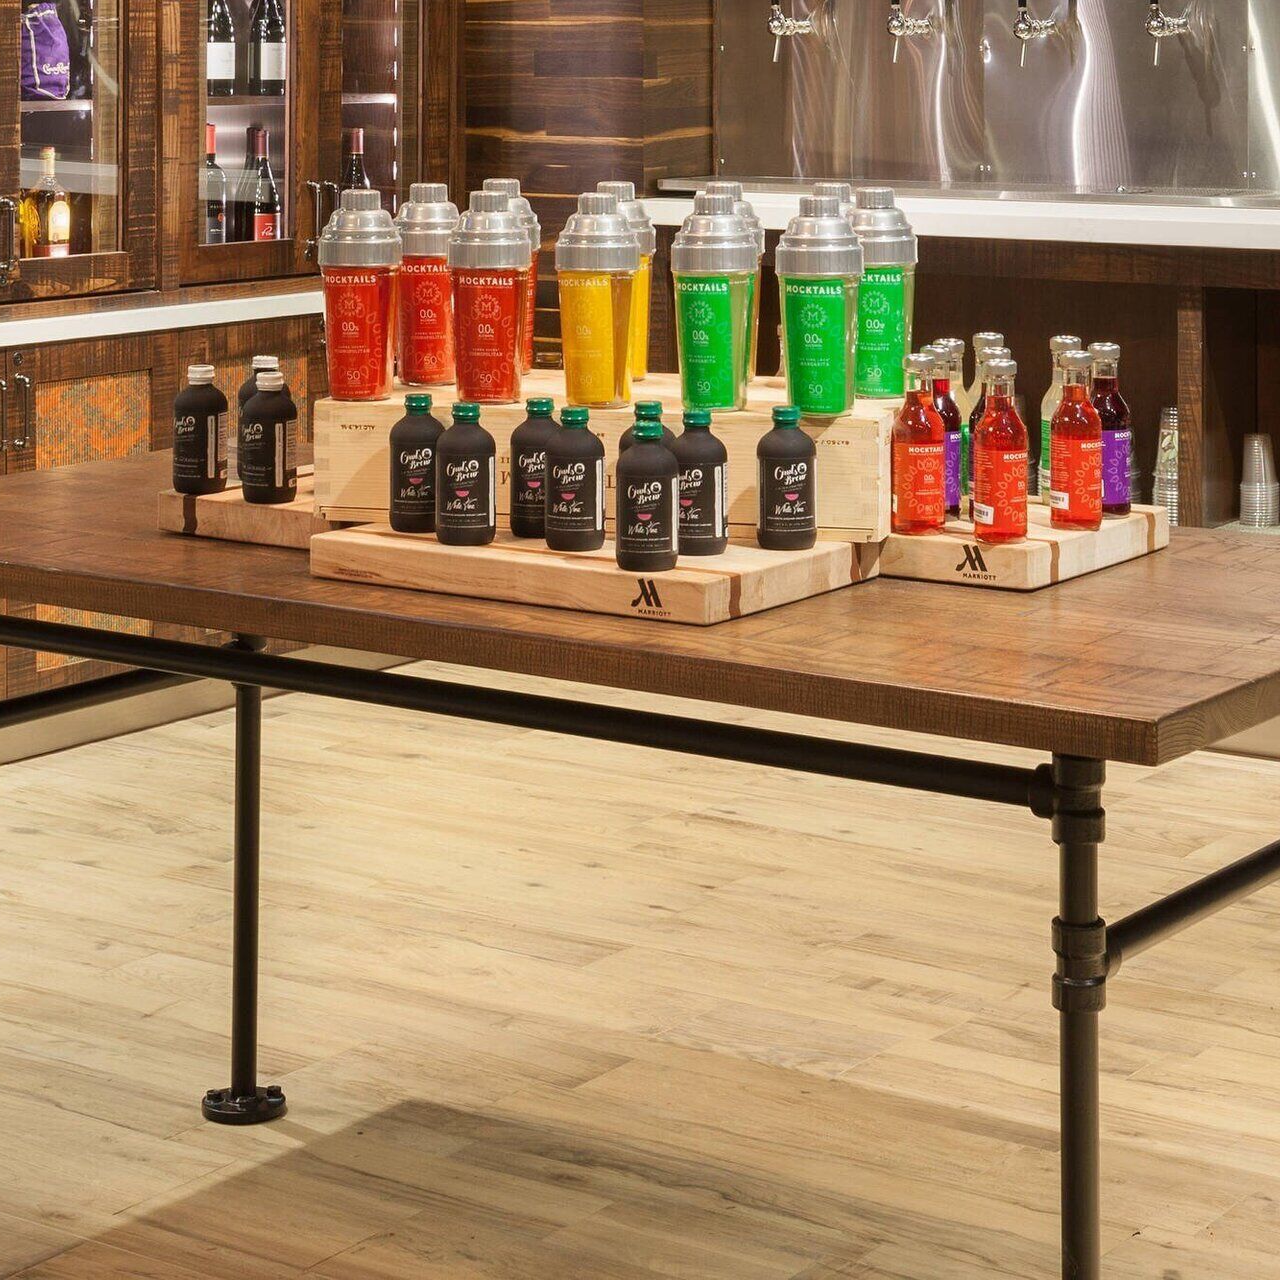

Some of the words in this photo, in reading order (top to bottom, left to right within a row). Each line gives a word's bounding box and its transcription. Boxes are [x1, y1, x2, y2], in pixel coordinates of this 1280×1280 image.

[460, 277, 513, 286] MOCKTAILS
[861, 274, 901, 282] CKTAILS
[786, 285, 841, 295] MOCKTAILS
[347, 371, 360, 380] 50
[410, 459, 431, 469] Brew
[456, 472, 479, 481] Brew
[562, 475, 585, 484] Brew
[784, 474, 807, 485] Brew
[637, 492, 662, 505] Brew
